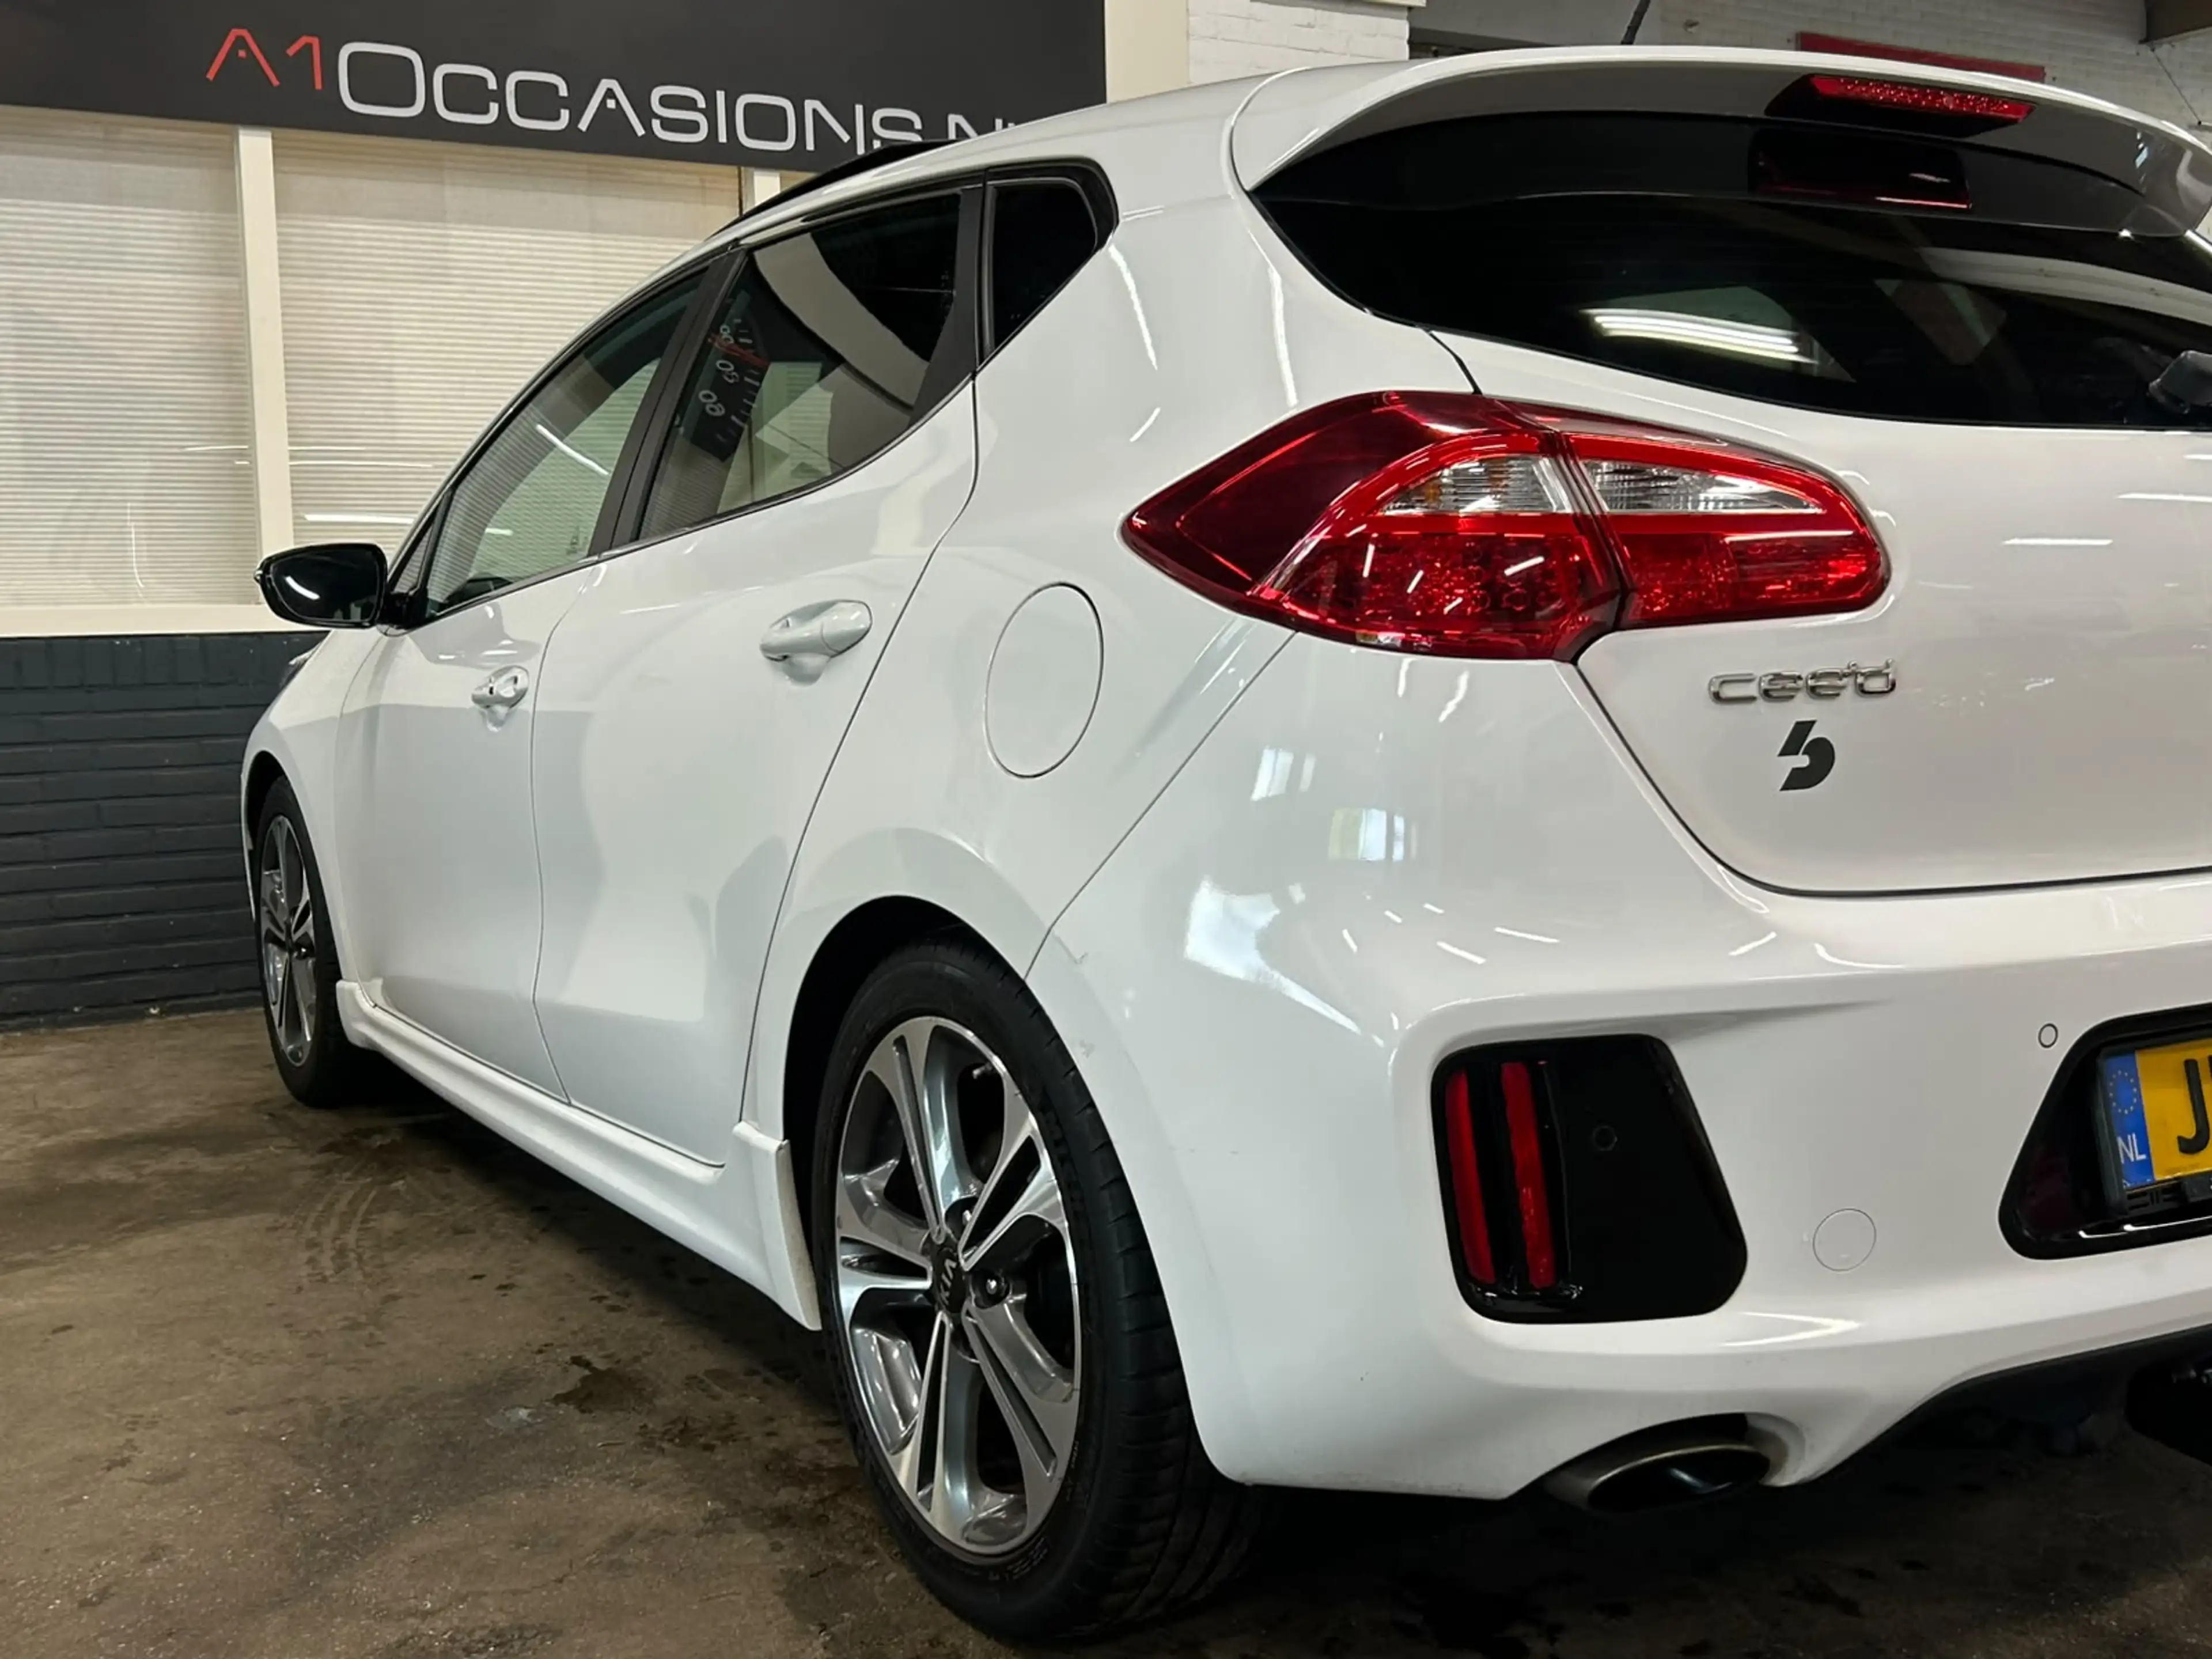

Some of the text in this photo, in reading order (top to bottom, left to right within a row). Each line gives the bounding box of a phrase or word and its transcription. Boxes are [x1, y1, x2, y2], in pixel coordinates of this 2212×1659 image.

[2177, 1055, 2212, 1155] J
[2116, 1132, 2147, 1164] NL
[940, 1259, 957, 1305] KIA
